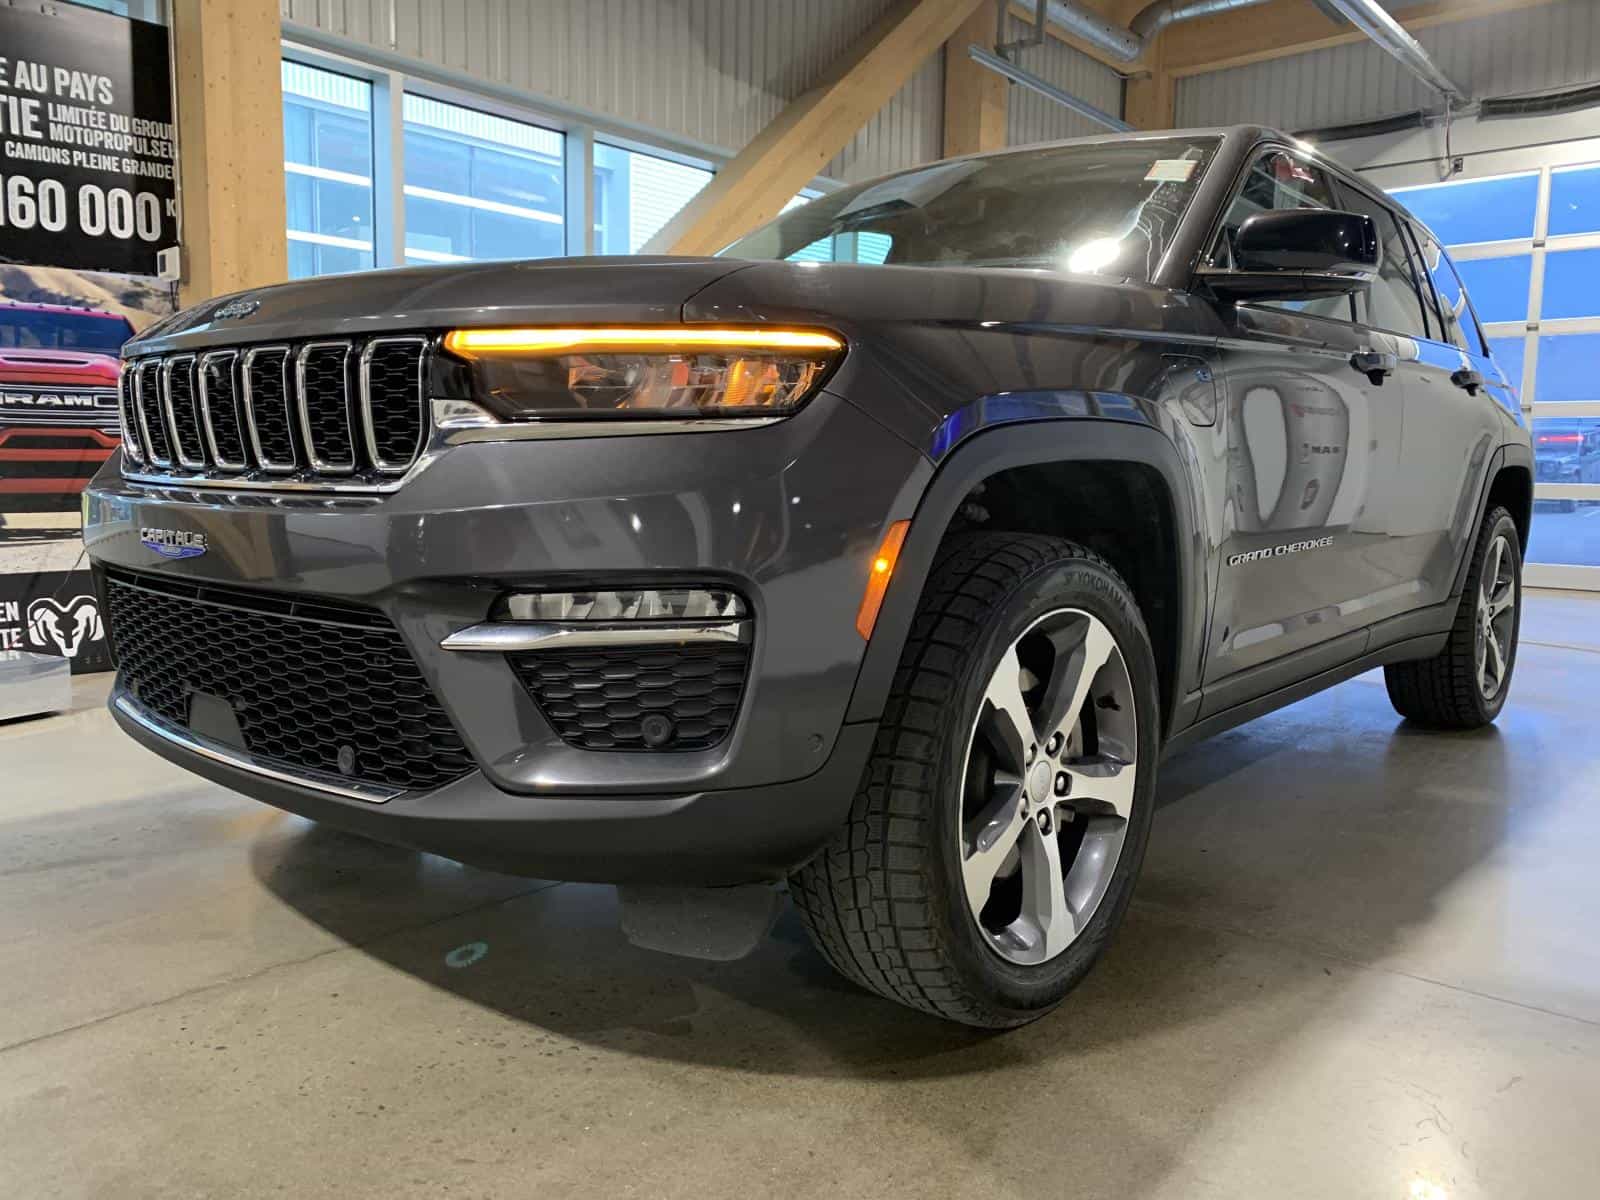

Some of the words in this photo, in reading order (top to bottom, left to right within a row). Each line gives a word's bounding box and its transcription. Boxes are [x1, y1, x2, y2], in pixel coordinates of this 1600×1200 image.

[14, 60, 47, 93] AU
[54, 67, 113, 105] PAYS
[48, 102, 106, 130] LIMITÉE
[110, 113, 129, 133] DU
[5, 141, 71, 166] CAMIONS
[73, 152, 120, 173] PLEINE
[122, 158, 174, 180] GRANDE
[0, 174, 67, 232] 60
[79, 184, 161, 242] 000
[4, 393, 92, 406] RAM
[1228, 547, 1273, 567] GRAND
[1275, 536, 1334, 557] CHEROKEE
